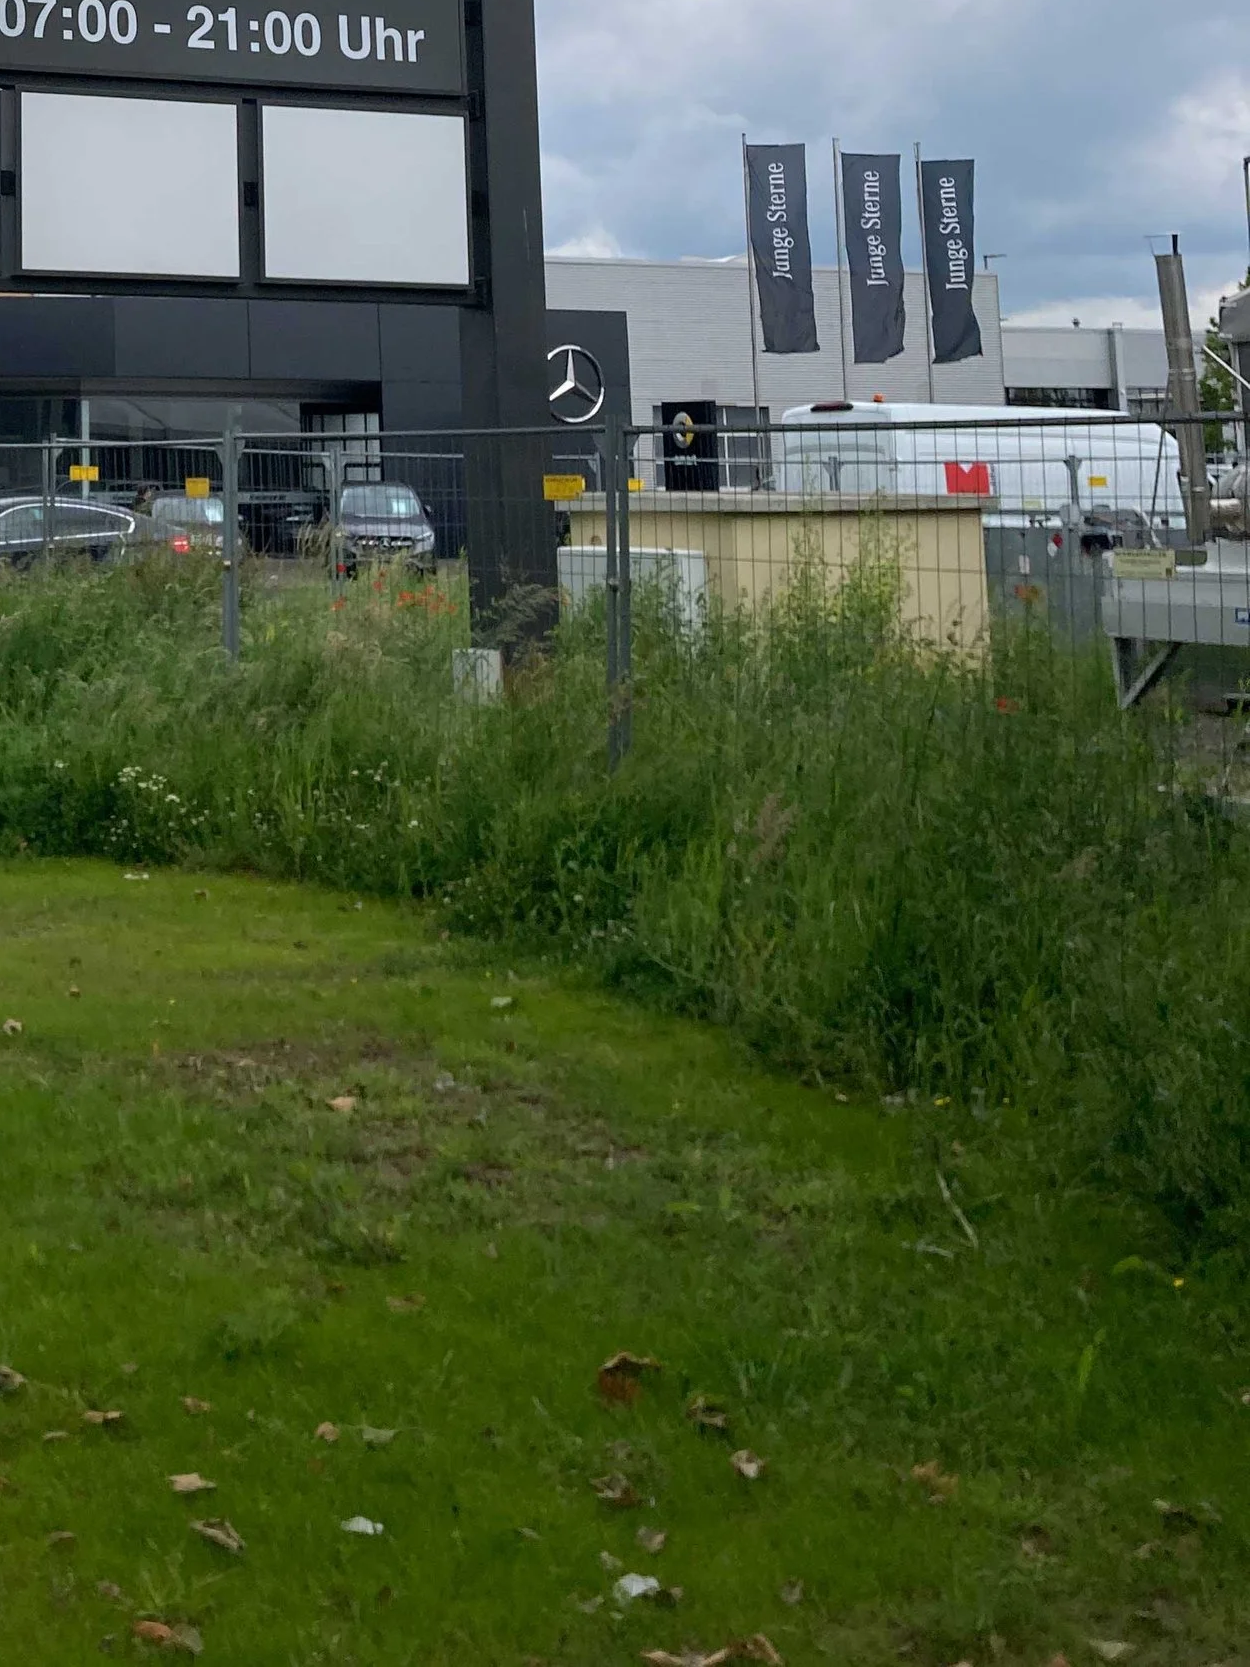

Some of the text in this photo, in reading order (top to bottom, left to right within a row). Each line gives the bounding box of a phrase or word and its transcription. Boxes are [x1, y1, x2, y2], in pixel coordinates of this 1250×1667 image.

[153, 23, 172, 34] -
[186, 4, 322, 58] 21:00
[338, 14, 426, 64] Uhr
[767, 161, 794, 280] Junge Sterne
[860, 169, 889, 286] Junge Sterne
[938, 176, 968, 290] Junge Sterne
